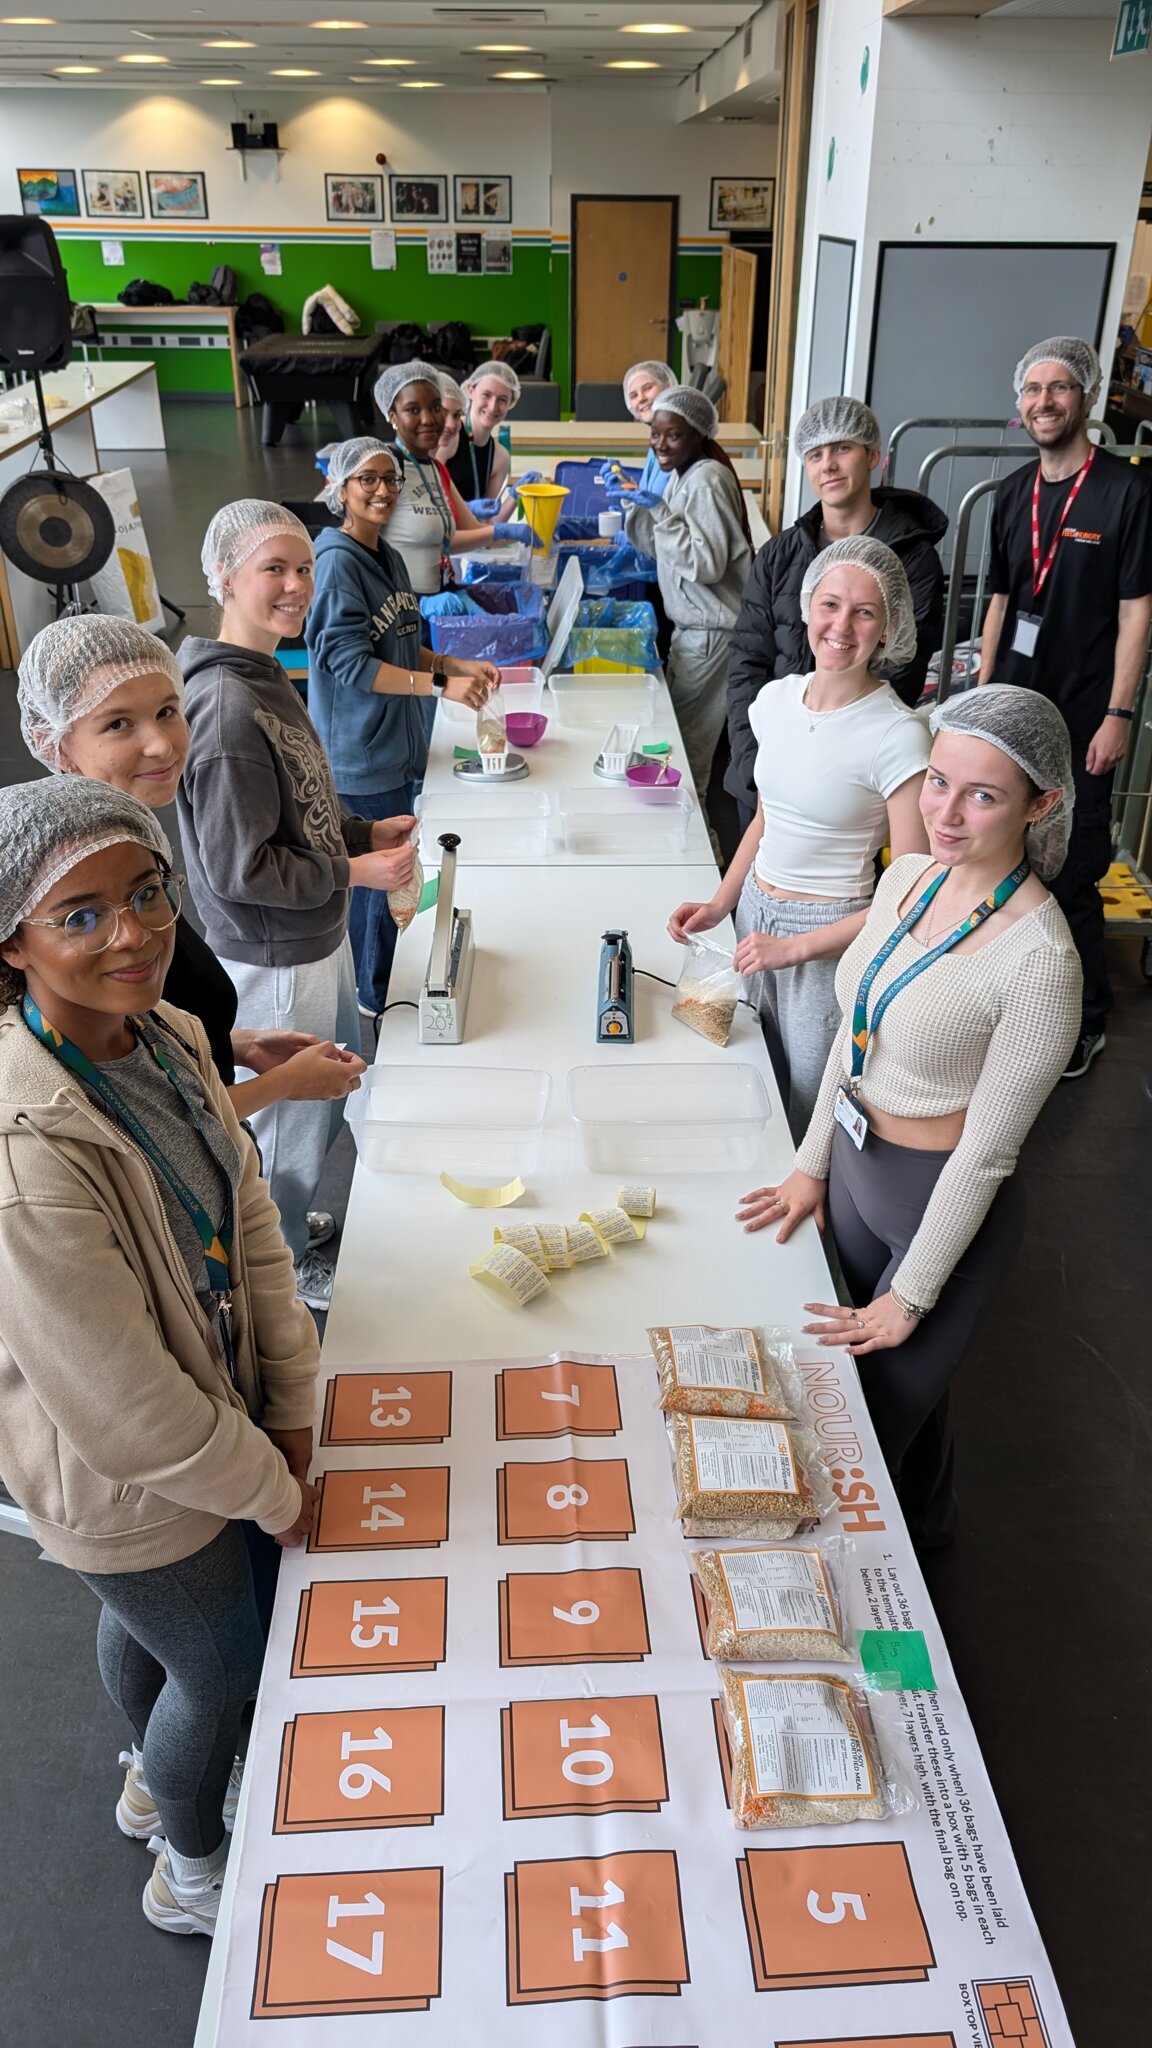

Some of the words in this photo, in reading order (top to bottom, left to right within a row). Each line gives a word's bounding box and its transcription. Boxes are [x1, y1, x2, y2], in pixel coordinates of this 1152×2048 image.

[893, 902, 925, 939] BARROW
[876, 937, 896, 962] HALL
[855, 963, 879, 1008] COLLEGE
[424, 1014, 454, 1031] 207
[99, 1080, 200, 1214] www.barrowhallcollege.co.uk
[370, 1386, 412, 1427] 13
[541, 1384, 580, 1407] 7
[361, 1483, 407, 1531] 14
[546, 1483, 589, 1510] 8
[882, 1553, 893, 1561] 1.
[874, 1567, 883, 1577] to
[886, 1567, 899, 1583] Lay
[877, 1577, 887, 1594] the
[892, 1582, 902, 1597] out
[552, 1599, 601, 1625] 9
[868, 1597, 878, 1606] 2
[881, 1593, 899, 1632] template
[898, 1597, 909, 1611] 36
[350, 1596, 401, 1649] 15
[870, 1602, 885, 1631] layers
[902, 1609, 914, 1630] bags
[911, 1689, 922, 1702] ut,
[902, 1710, 914, 1718] 7
[915, 1702, 934, 1746] transfer
[931, 1712, 950, 1736] (and
[559, 1713, 614, 1786] 10
[904, 1720, 920, 1753] layers
[337, 1725, 393, 1801] 16
[850, 1738, 860, 1772] FORTIFIED
[855, 1739, 865, 1768] RICE-SOY
[927, 1747, 943, 1777] these
[940, 1738, 955, 1762] only
[936, 1779, 950, 1801] into
[948, 1763, 968, 1797] when)
[921, 1781, 937, 1807] with
[958, 1798, 973, 1813] 36
[929, 1808, 941, 1828] the
[946, 1810, 960, 1832] box
[963, 1814, 979, 1842] bags
[934, 1828, 953, 1855] final
[953, 1833, 970, 1861] with
[942, 1856, 956, 1881] bag
[961, 1864, 973, 1872] 5
[972, 1844, 988, 1874] have
[949, 1882, 961, 1898] on
[963, 1874, 980, 1903] bags
[981, 1875, 998, 1906] been
[806, 1889, 867, 1925] 5
[954, 1899, 968, 1922] top.
[972, 1904, 985, 1915] in
[991, 1907, 1010, 1929] laid
[325, 1891, 386, 1976] 17
[569, 1879, 629, 1962] 11
[977, 1916, 996, 1945] each
[959, 1982, 973, 2008] BOX
[965, 2008, 978, 2031] TOP
